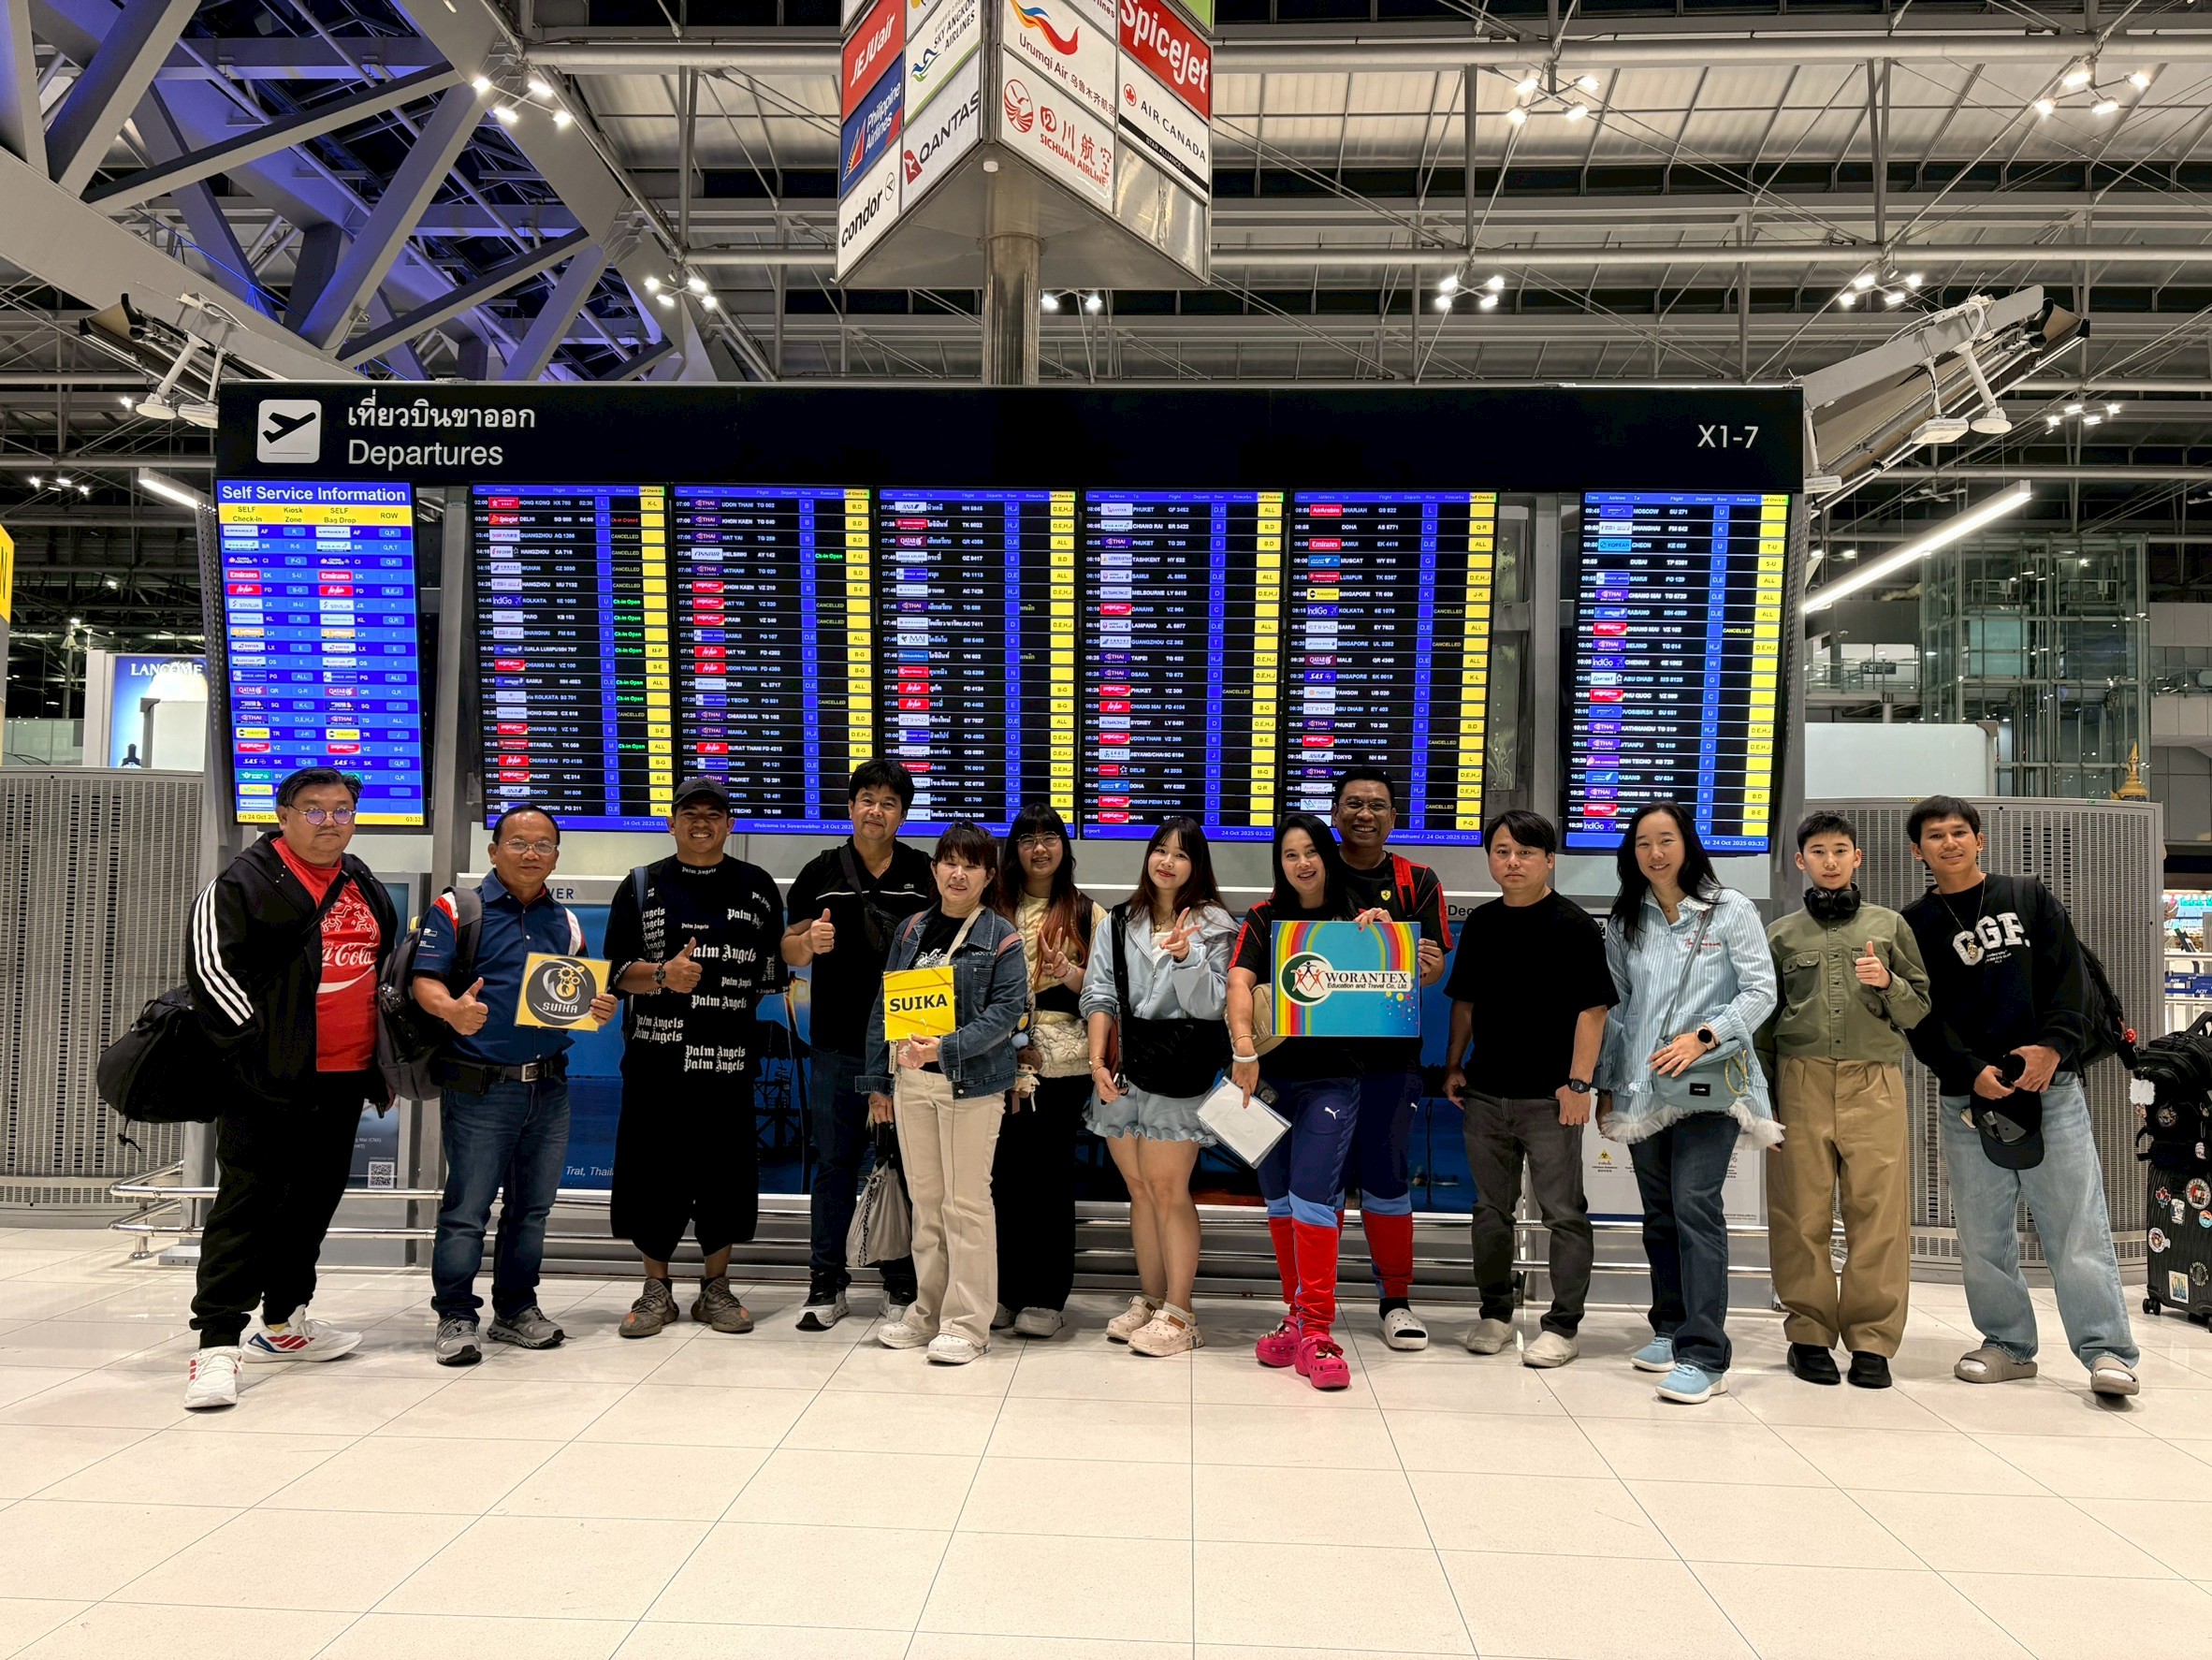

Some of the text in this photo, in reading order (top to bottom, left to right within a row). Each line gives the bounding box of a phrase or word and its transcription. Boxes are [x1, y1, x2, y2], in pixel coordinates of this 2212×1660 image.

[945, 9, 975, 51] AIRLINES
[851, 13, 895, 88] JEJUair
[1020, 33, 1068, 80] Urumqi Air
[1120, 0, 1209, 94] SpiceJet
[867, 83, 900, 132] Philippine
[1070, 74, 1115, 117] 乌鲁木齐航空
[866, 112, 892, 153] Airlines
[920, 91, 979, 164] QANTAS
[1041, 106, 1113, 176] 四川航空
[1141, 101, 1206, 163] AIR CANADA
[1040, 134, 1109, 187] SICHUAN AIRLINE
[1145, 138, 1158, 153] STAR
[841, 190, 882, 248] condor
[347, 388, 536, 429] เที่ยวบินขาออก
[1697, 425, 1758, 448] X1-7
[348, 440, 503, 471] Departures
[222, 486, 406, 501] Self Service Information
[727, 909, 751, 921] Palm
[684, 943, 756, 963] alm Angels
[1325, 972, 1408, 983] WORANTEX
[691, 995, 720, 1009] Palm
[890, 994, 948, 1012] SUIKA
[650, 1029, 682, 1044] Angels
[653, 1017, 684, 1030] Angels
[684, 1058, 745, 1073] Palm Angels
[685, 1045, 746, 1059] Palm Angels
[566, 1166, 585, 1176] Trat,
